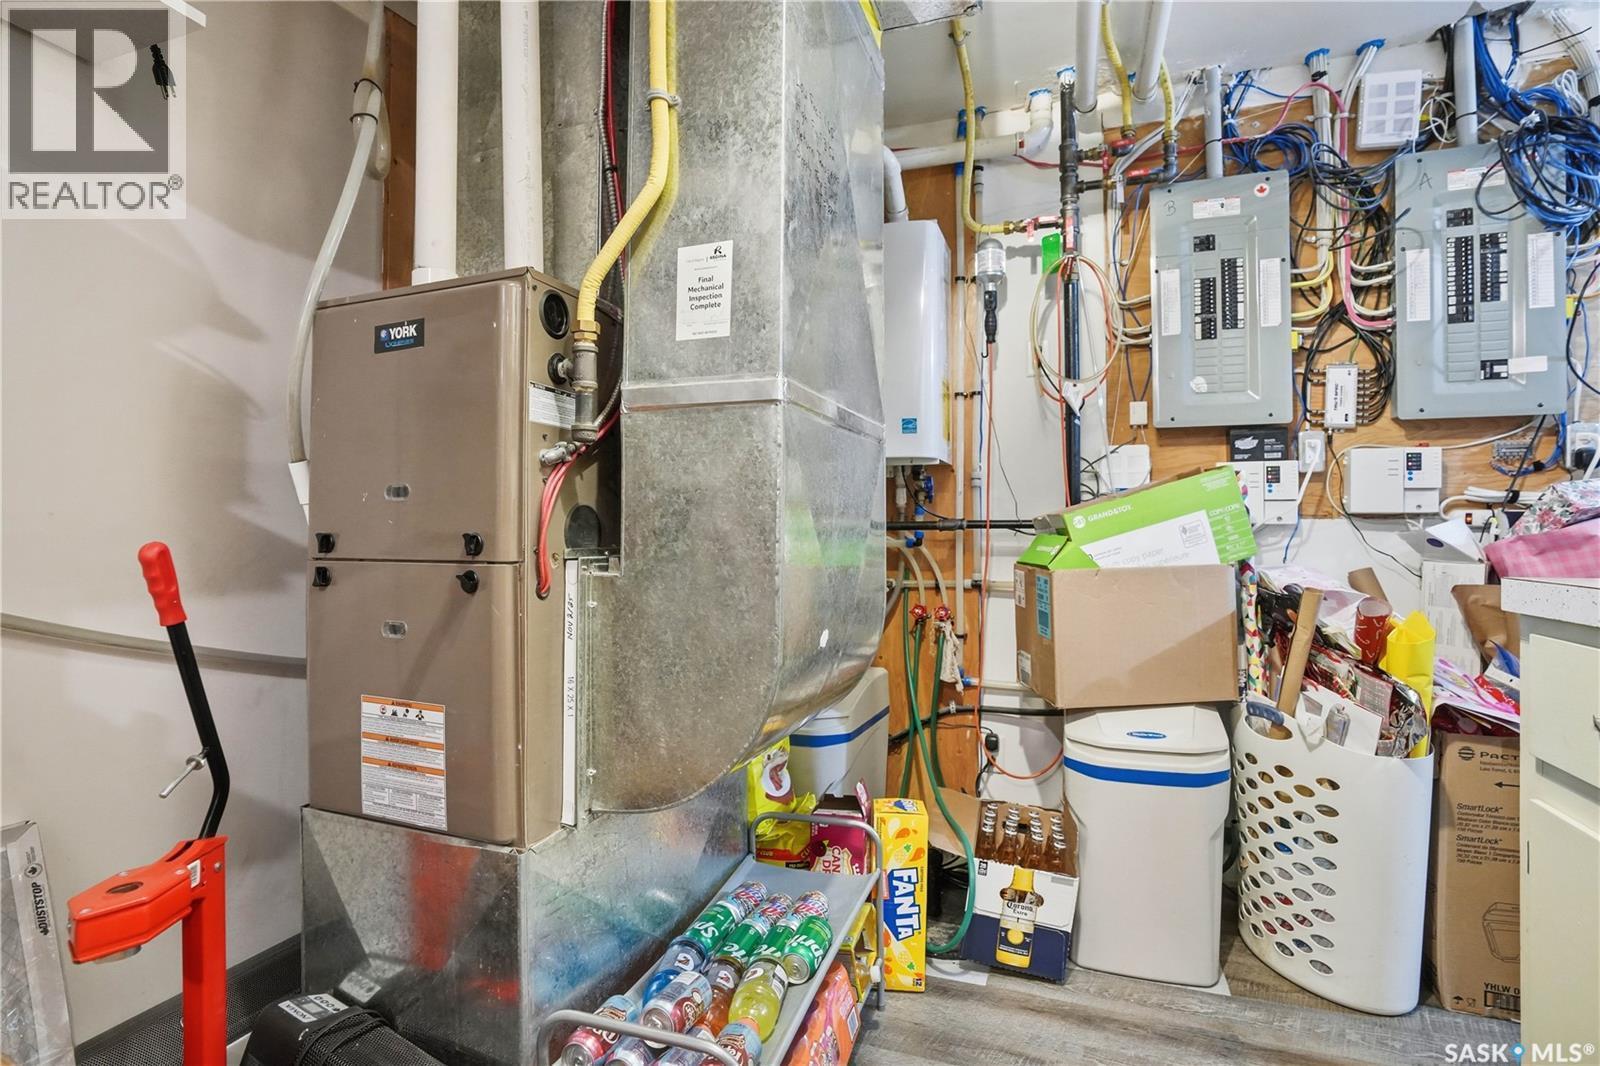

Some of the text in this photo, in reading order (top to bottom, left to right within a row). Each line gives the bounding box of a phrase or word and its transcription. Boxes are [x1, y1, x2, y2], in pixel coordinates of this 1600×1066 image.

[1420, 172, 1433, 191] A
[1164, 200, 1176, 217] B
[698, 274, 714, 283] Final
[688, 282, 725, 293] Mechanical
[688, 292, 723, 302] Inspection
[690, 301, 722, 311] Complete
[389, 323, 418, 340] YORK
[567, 694, 575, 704] 25
[31, 881, 49, 929] DUSTSTOP
[892, 868, 921, 939] FANTA
[1006, 900, 1034, 912] Corona
[1012, 908, 1028, 917] Extra
[1484, 982, 1512, 994] YHLW
